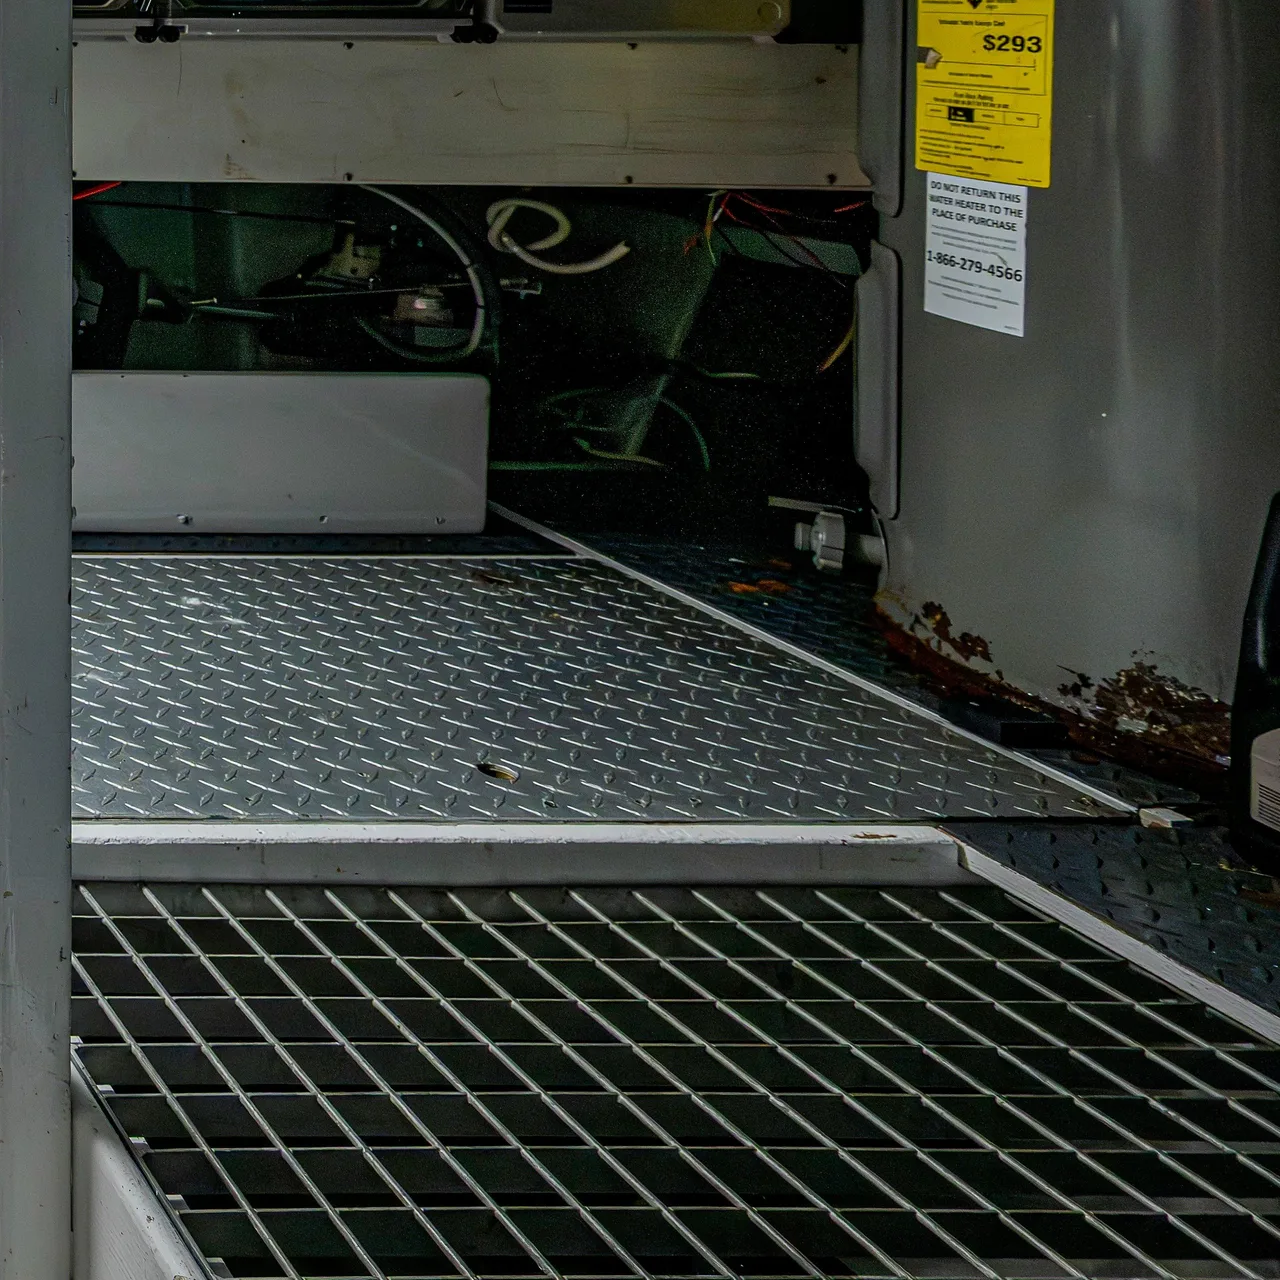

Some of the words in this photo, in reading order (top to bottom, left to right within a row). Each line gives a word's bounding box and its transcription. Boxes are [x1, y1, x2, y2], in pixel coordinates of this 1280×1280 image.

[982, 34, 1043, 53] $293
[931, 180, 941, 190] DO
[943, 183, 959, 193] NOT
[961, 185, 996, 200] RETURN
[998, 192, 1021, 204] THIS
[929, 193, 953, 206] WATER
[955, 198, 987, 212] HEATER
[988, 205, 1001, 215] TO
[1004, 207, 1023, 219] THE
[931, 207, 954, 220] PLACE
[955, 212, 966, 222] OF
[968, 215, 1017, 232] PURCHASE
[927, 250, 1023, 282] 1-866-279-4566
